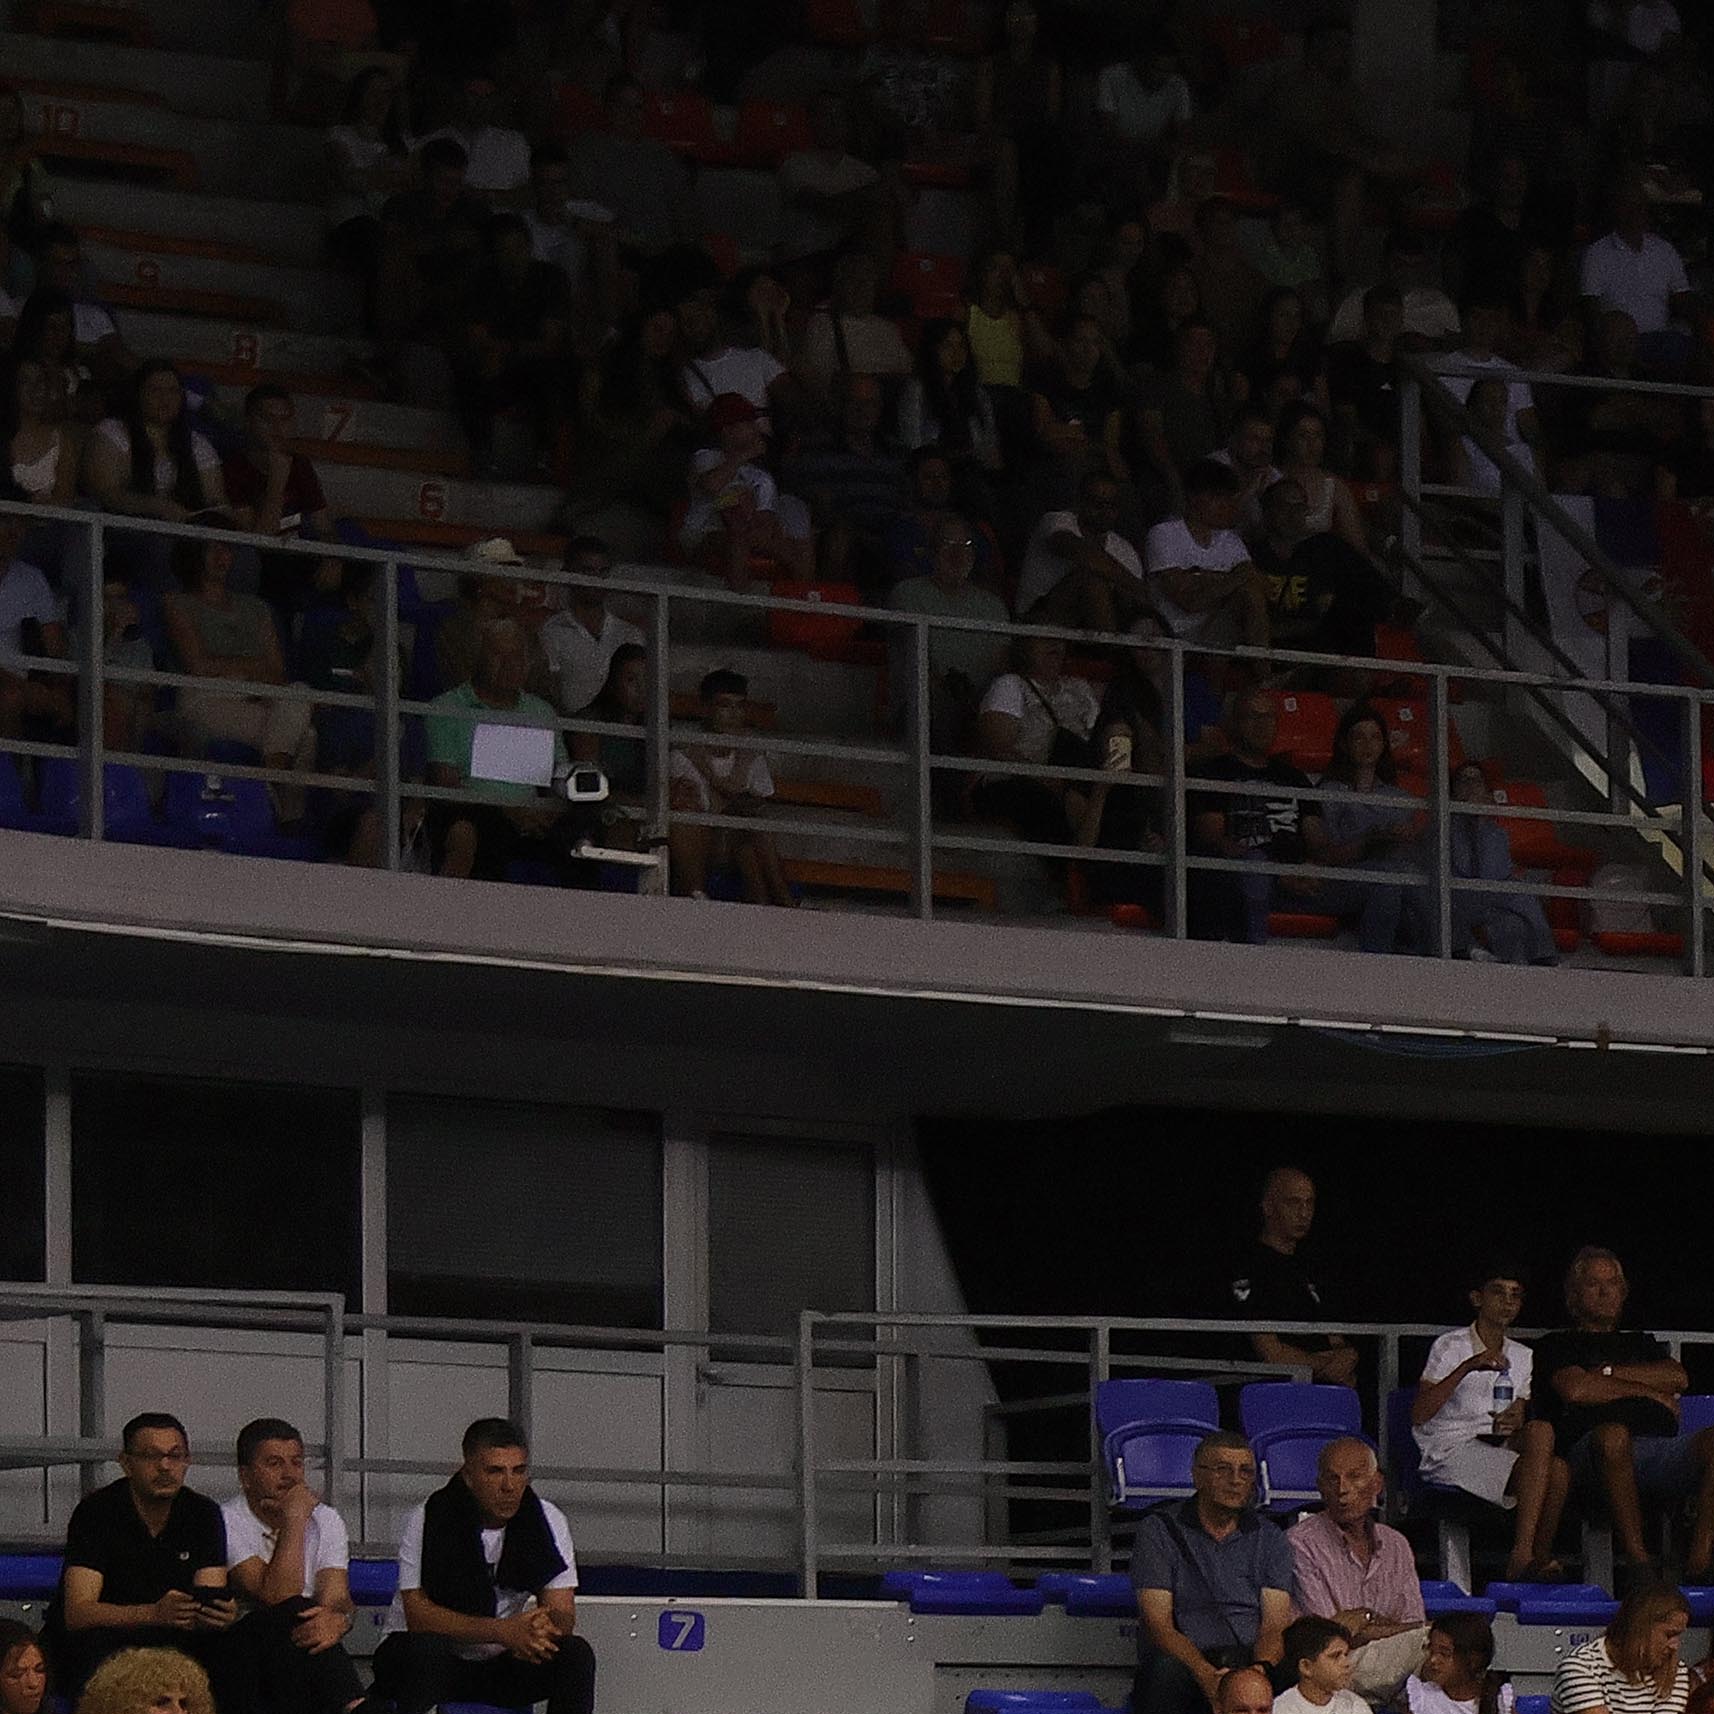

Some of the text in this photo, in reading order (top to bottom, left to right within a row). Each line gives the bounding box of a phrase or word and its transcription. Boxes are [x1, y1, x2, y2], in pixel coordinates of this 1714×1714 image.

[325, 406, 354, 442] 7
[419, 483, 446, 519] 6
[670, 1614, 696, 1650] 7
